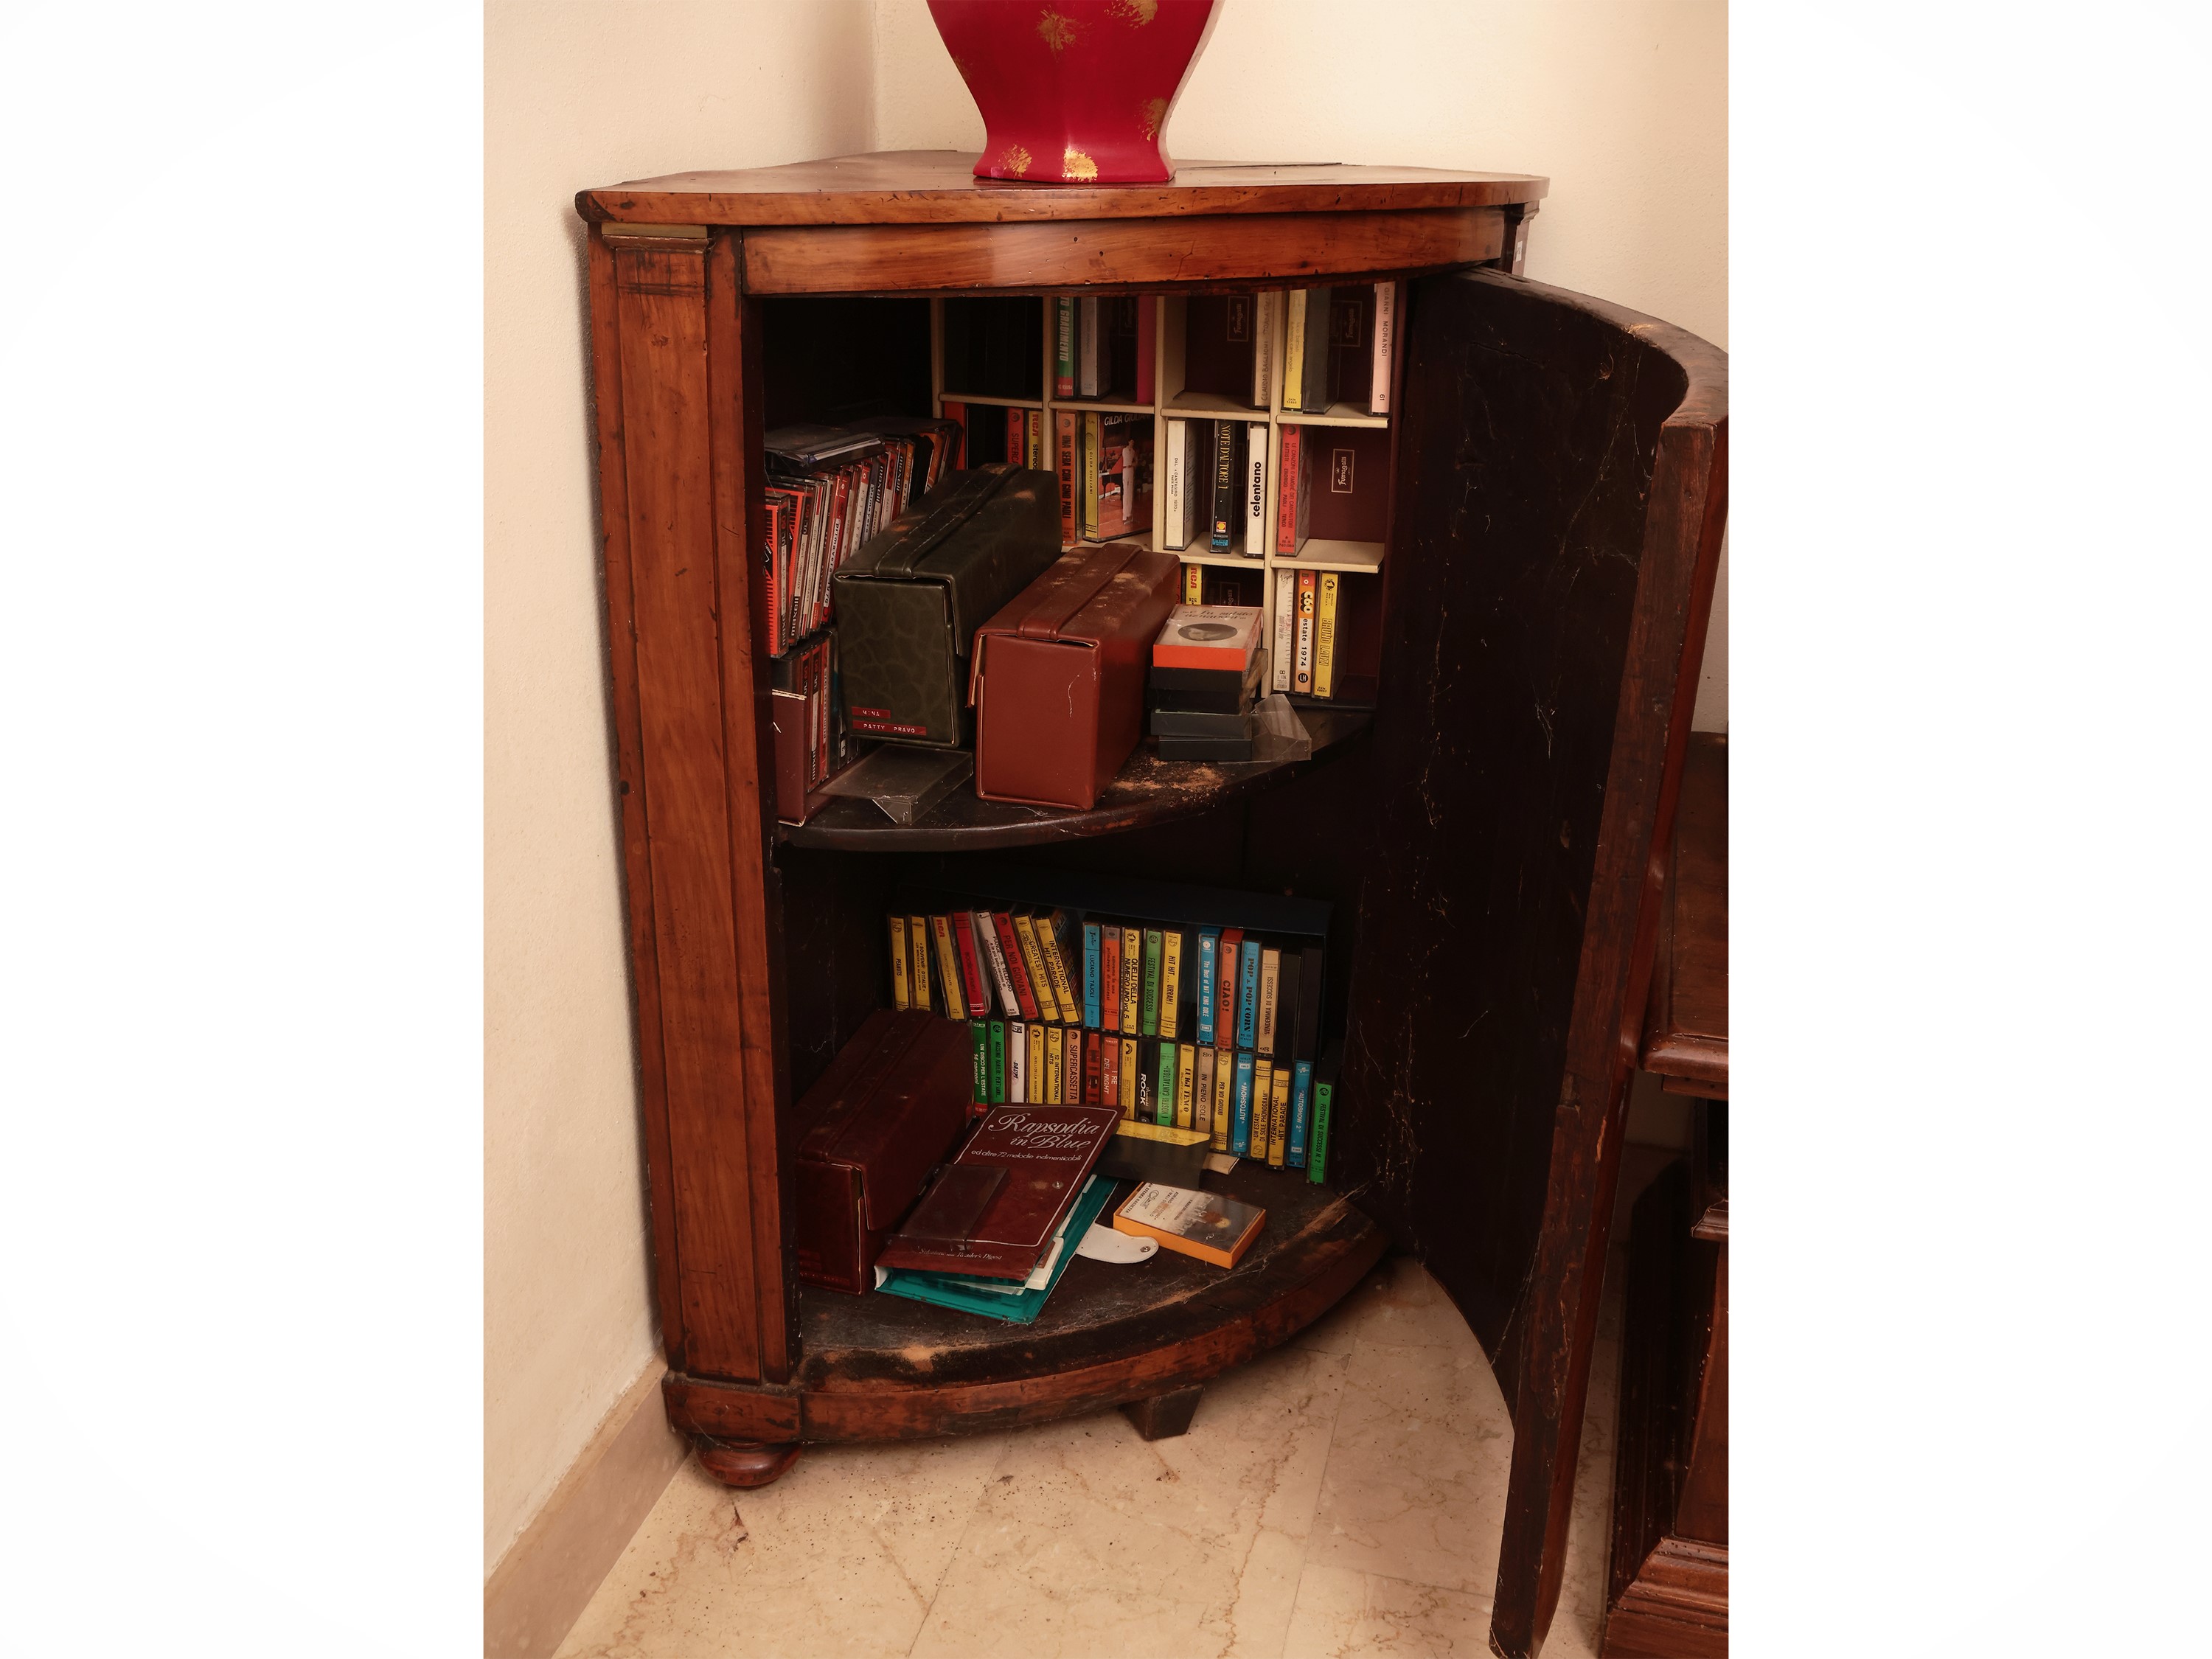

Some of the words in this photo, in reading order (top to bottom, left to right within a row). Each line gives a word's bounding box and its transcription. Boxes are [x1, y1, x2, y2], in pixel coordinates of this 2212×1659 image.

[1060, 310, 1070, 362] GRADIMENTO
[1381, 321, 1389, 357] MORANDI
[1262, 341, 1270, 372] BAGLIONI
[1104, 415, 1123, 426] GILDA
[1062, 435, 1071, 448] UNA
[1220, 424, 1231, 446] NOTE
[1062, 451, 1071, 466] SERA
[1218, 447, 1231, 483] D'AUTORE
[875, 465, 884, 502] maxell
[894, 455, 903, 493] maxell
[1062, 469, 1071, 482] CON
[1062, 484, 1071, 498] GINO
[1250, 462, 1262, 518] celentano
[866, 487, 875, 534] primavera
[1062, 501, 1071, 519] PAOLI
[801, 521, 808, 535] UL
[830, 522, 840, 574] primavera
[1300, 591, 1313, 615] C60
[790, 597, 799, 636] maxell
[1321, 618, 1333, 644] BRUNO
[1319, 645, 1331, 666] LAUZI
[863, 723, 886, 731] PATTY
[894, 726, 916, 734] PRAVO
[936, 919, 945, 938] RCA
[1003, 935, 1011, 949] PER
[1008, 951, 1017, 965] NOI
[1029, 941, 1043, 971] GREATEST
[1038, 973, 1048, 988] HITS
[1043, 947, 1052, 959] HIT
[1048, 961, 1060, 989] PARADE
[1048, 940, 1070, 994] INTERNATIONAL
[1147, 957, 1155, 978] FESTIVAL
[1168, 956, 1176, 964] HIT
[1246, 958, 1254, 977] POP
[995, 967, 1005, 981] canzoni
[1001, 967, 1014, 992] TELEFONO
[1012, 967, 1027, 996] GIOVANI
[1166, 984, 1175, 1004] URRAH!
[1222, 979, 1231, 1012] CIAO!
[1245, 986, 1253, 1006] POP
[1266, 976, 1274, 999] SUCCESSI
[1146, 988, 1155, 1012] SUCCESSI
[1244, 1006, 1252, 1032] CORN
[1264, 1006, 1272, 1034] VENDEMMIA
[1069, 1044, 1078, 1100] SUPERCASSETTA
[1111, 1075, 1118, 1085] RE
[1161, 1098, 1170, 1115] NOSTRI
[1279, 1102, 1287, 1127] PARADE
[1318, 1103, 1327, 1122] FESTIVAL
[988, 1113, 1101, 1139] Rapsodia
[1270, 1096, 1279, 1146] INTERNATIONAL
[1009, 1136, 1028, 1147] in
[1027, 1133, 1092, 1153] Blue
[1316, 1130, 1324, 1153] SUCCESSI
[970, 1148, 982, 1156] ed
[981, 1150, 998, 1158] altre
[1035, 1153, 1083, 1162] indimenticabili
